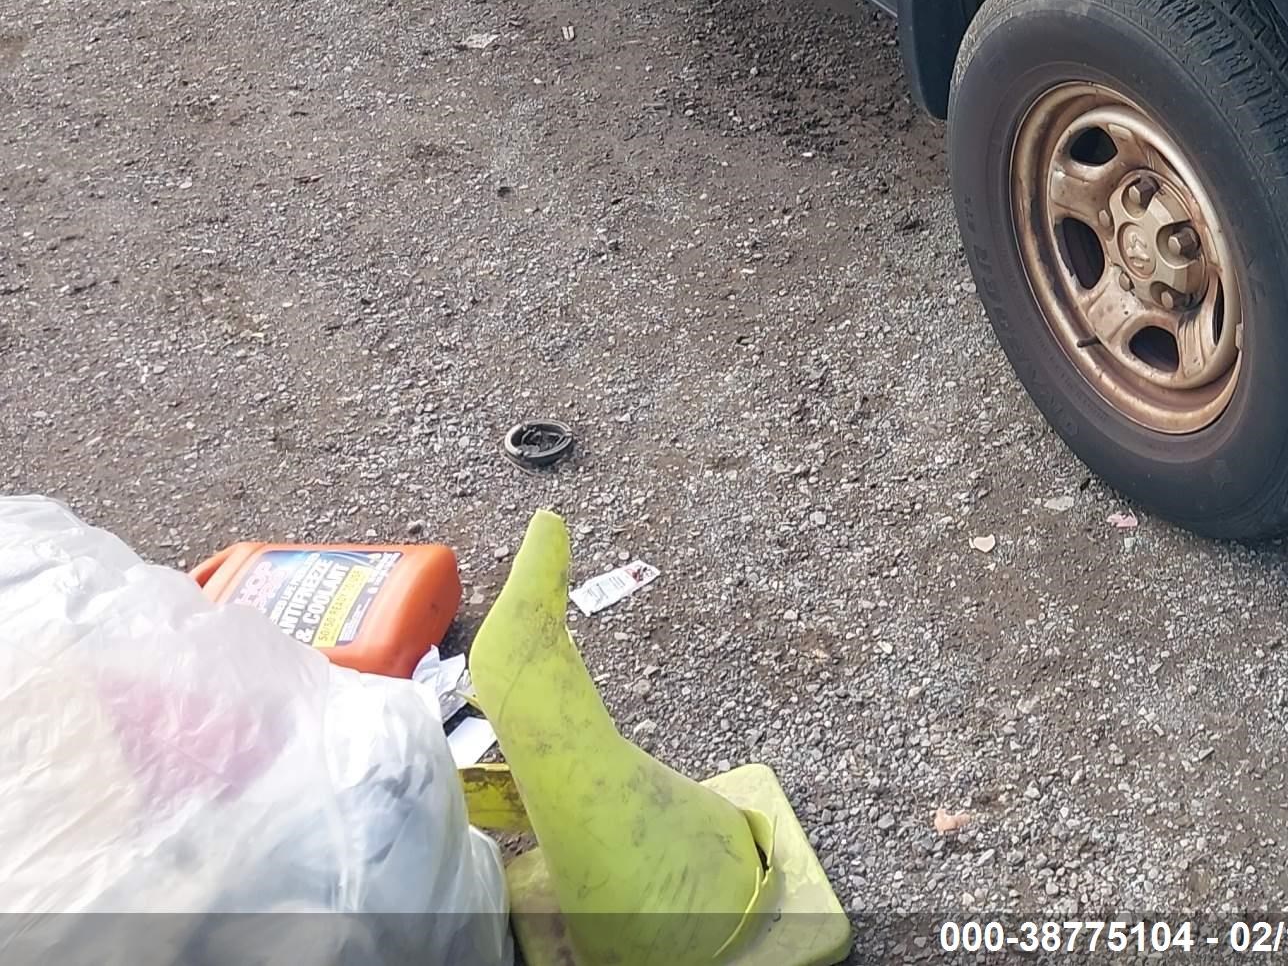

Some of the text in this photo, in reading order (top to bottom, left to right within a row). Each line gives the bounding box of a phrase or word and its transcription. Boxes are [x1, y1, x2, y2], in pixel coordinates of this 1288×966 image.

[232, 561, 272, 605] HOP
[276, 558, 334, 635] ANTIFREEZE
[295, 563, 350, 643] & COOLANT
